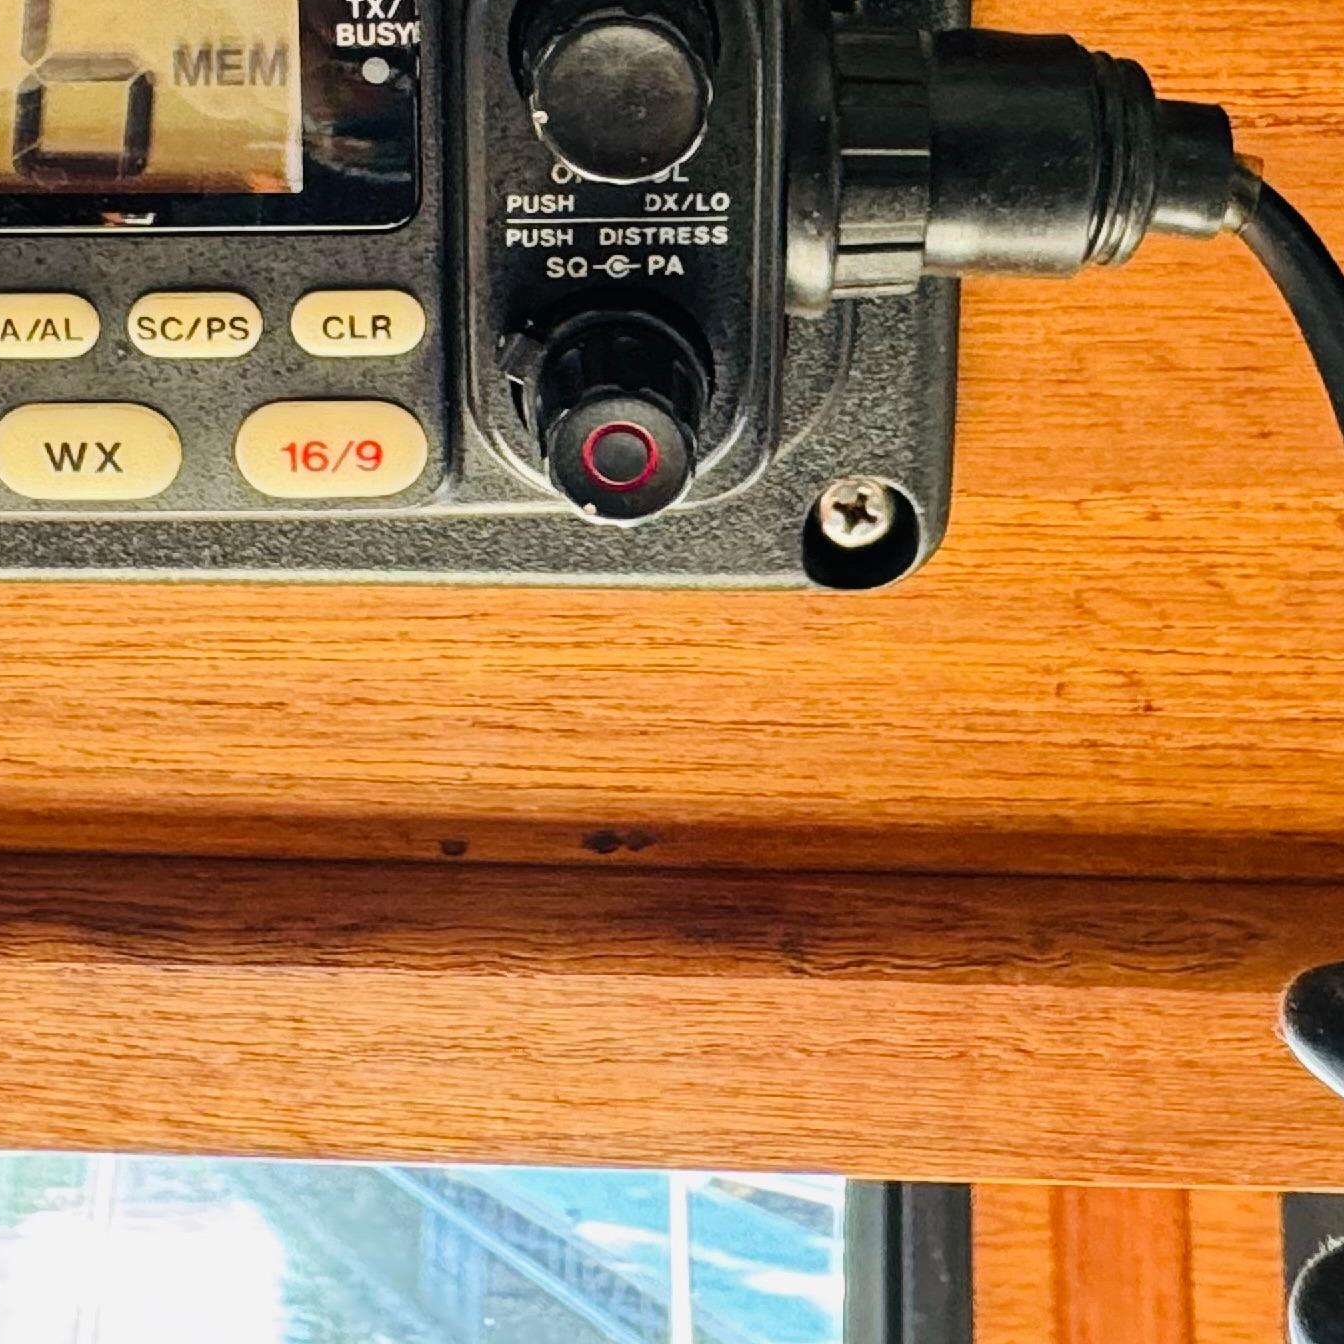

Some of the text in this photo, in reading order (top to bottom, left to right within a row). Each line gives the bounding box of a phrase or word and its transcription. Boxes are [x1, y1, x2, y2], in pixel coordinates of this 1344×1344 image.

[335, 22, 413, 47] BUSY
[171, 43, 288, 87] MEM
[505, 191, 732, 215] PUSH DX/LO
[505, 225, 730, 249] PUSH DISTRESS
[545, 254, 686, 279] SQ PA
[136, 315, 250, 342] SC/PS
[321, 314, 393, 340] CLR
[43, 440, 125, 473] WX
[280, 439, 385, 473] 16/9
